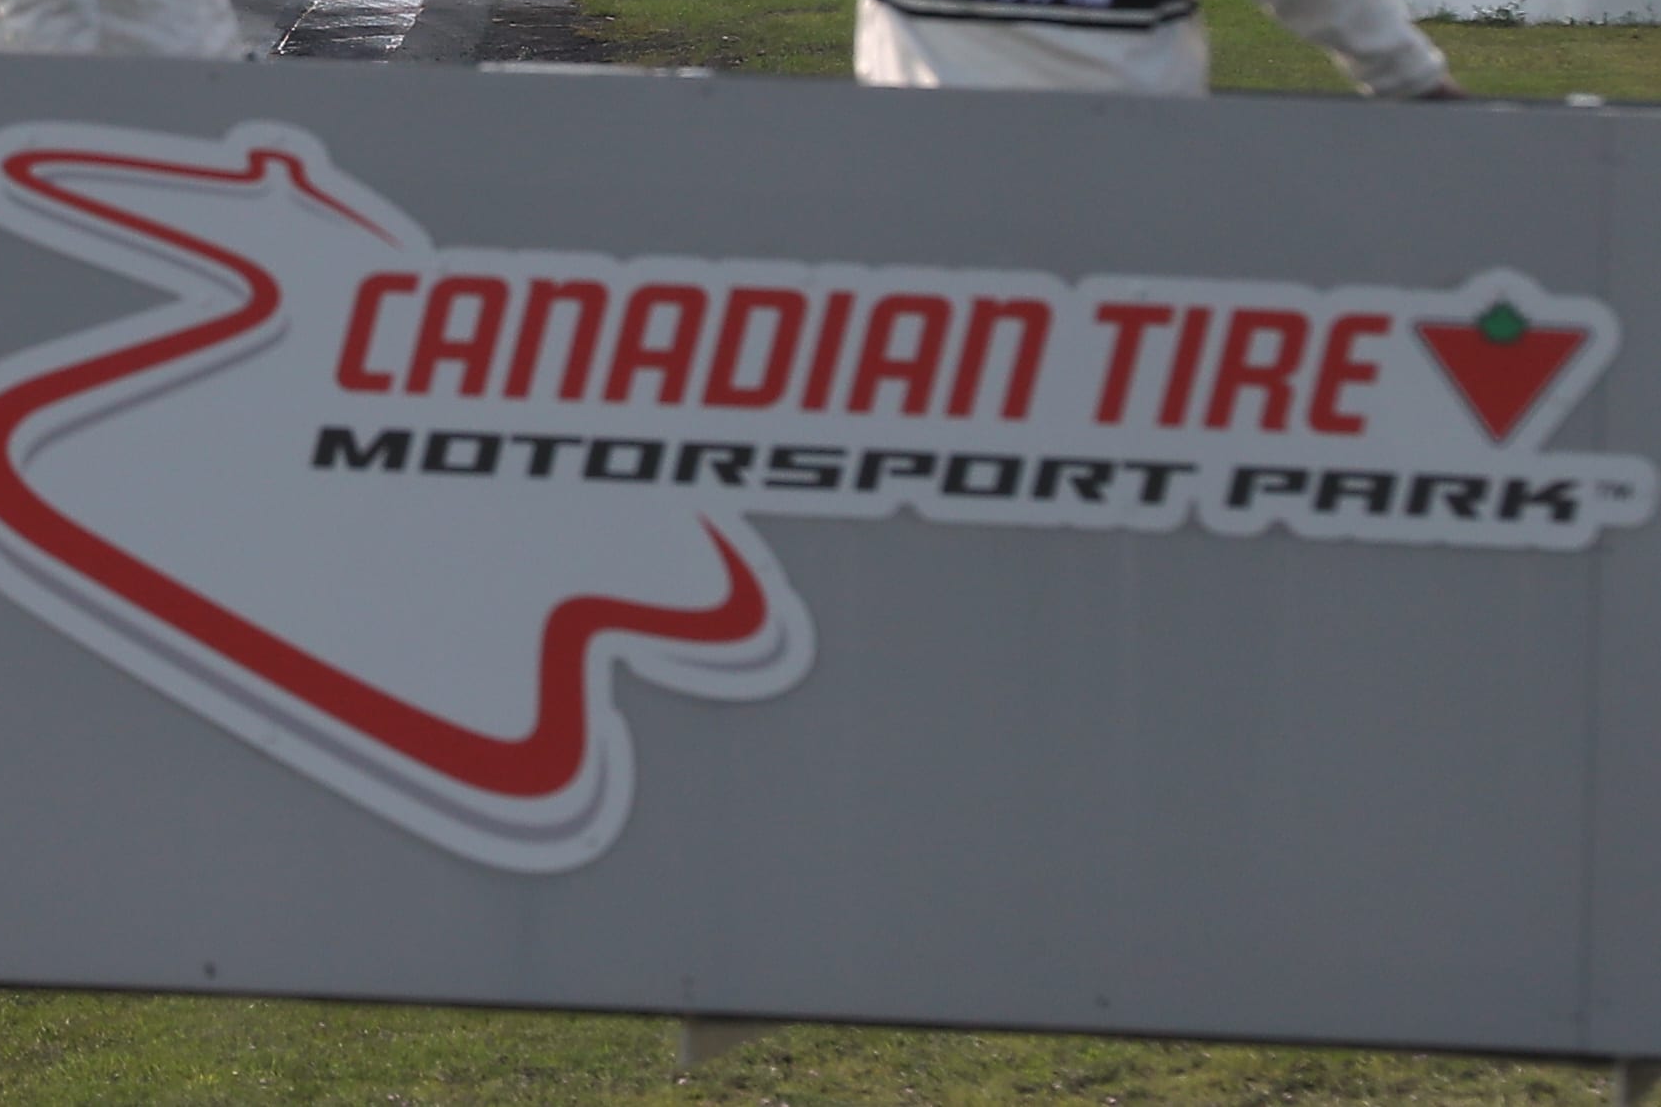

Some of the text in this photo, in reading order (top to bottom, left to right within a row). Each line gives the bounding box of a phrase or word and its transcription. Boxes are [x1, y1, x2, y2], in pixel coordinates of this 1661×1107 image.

[334, 271, 1394, 436] CANADIAN TIRE
[310, 426, 1198, 506] MOTORSPORT
[1228, 464, 1582, 523] PARK
